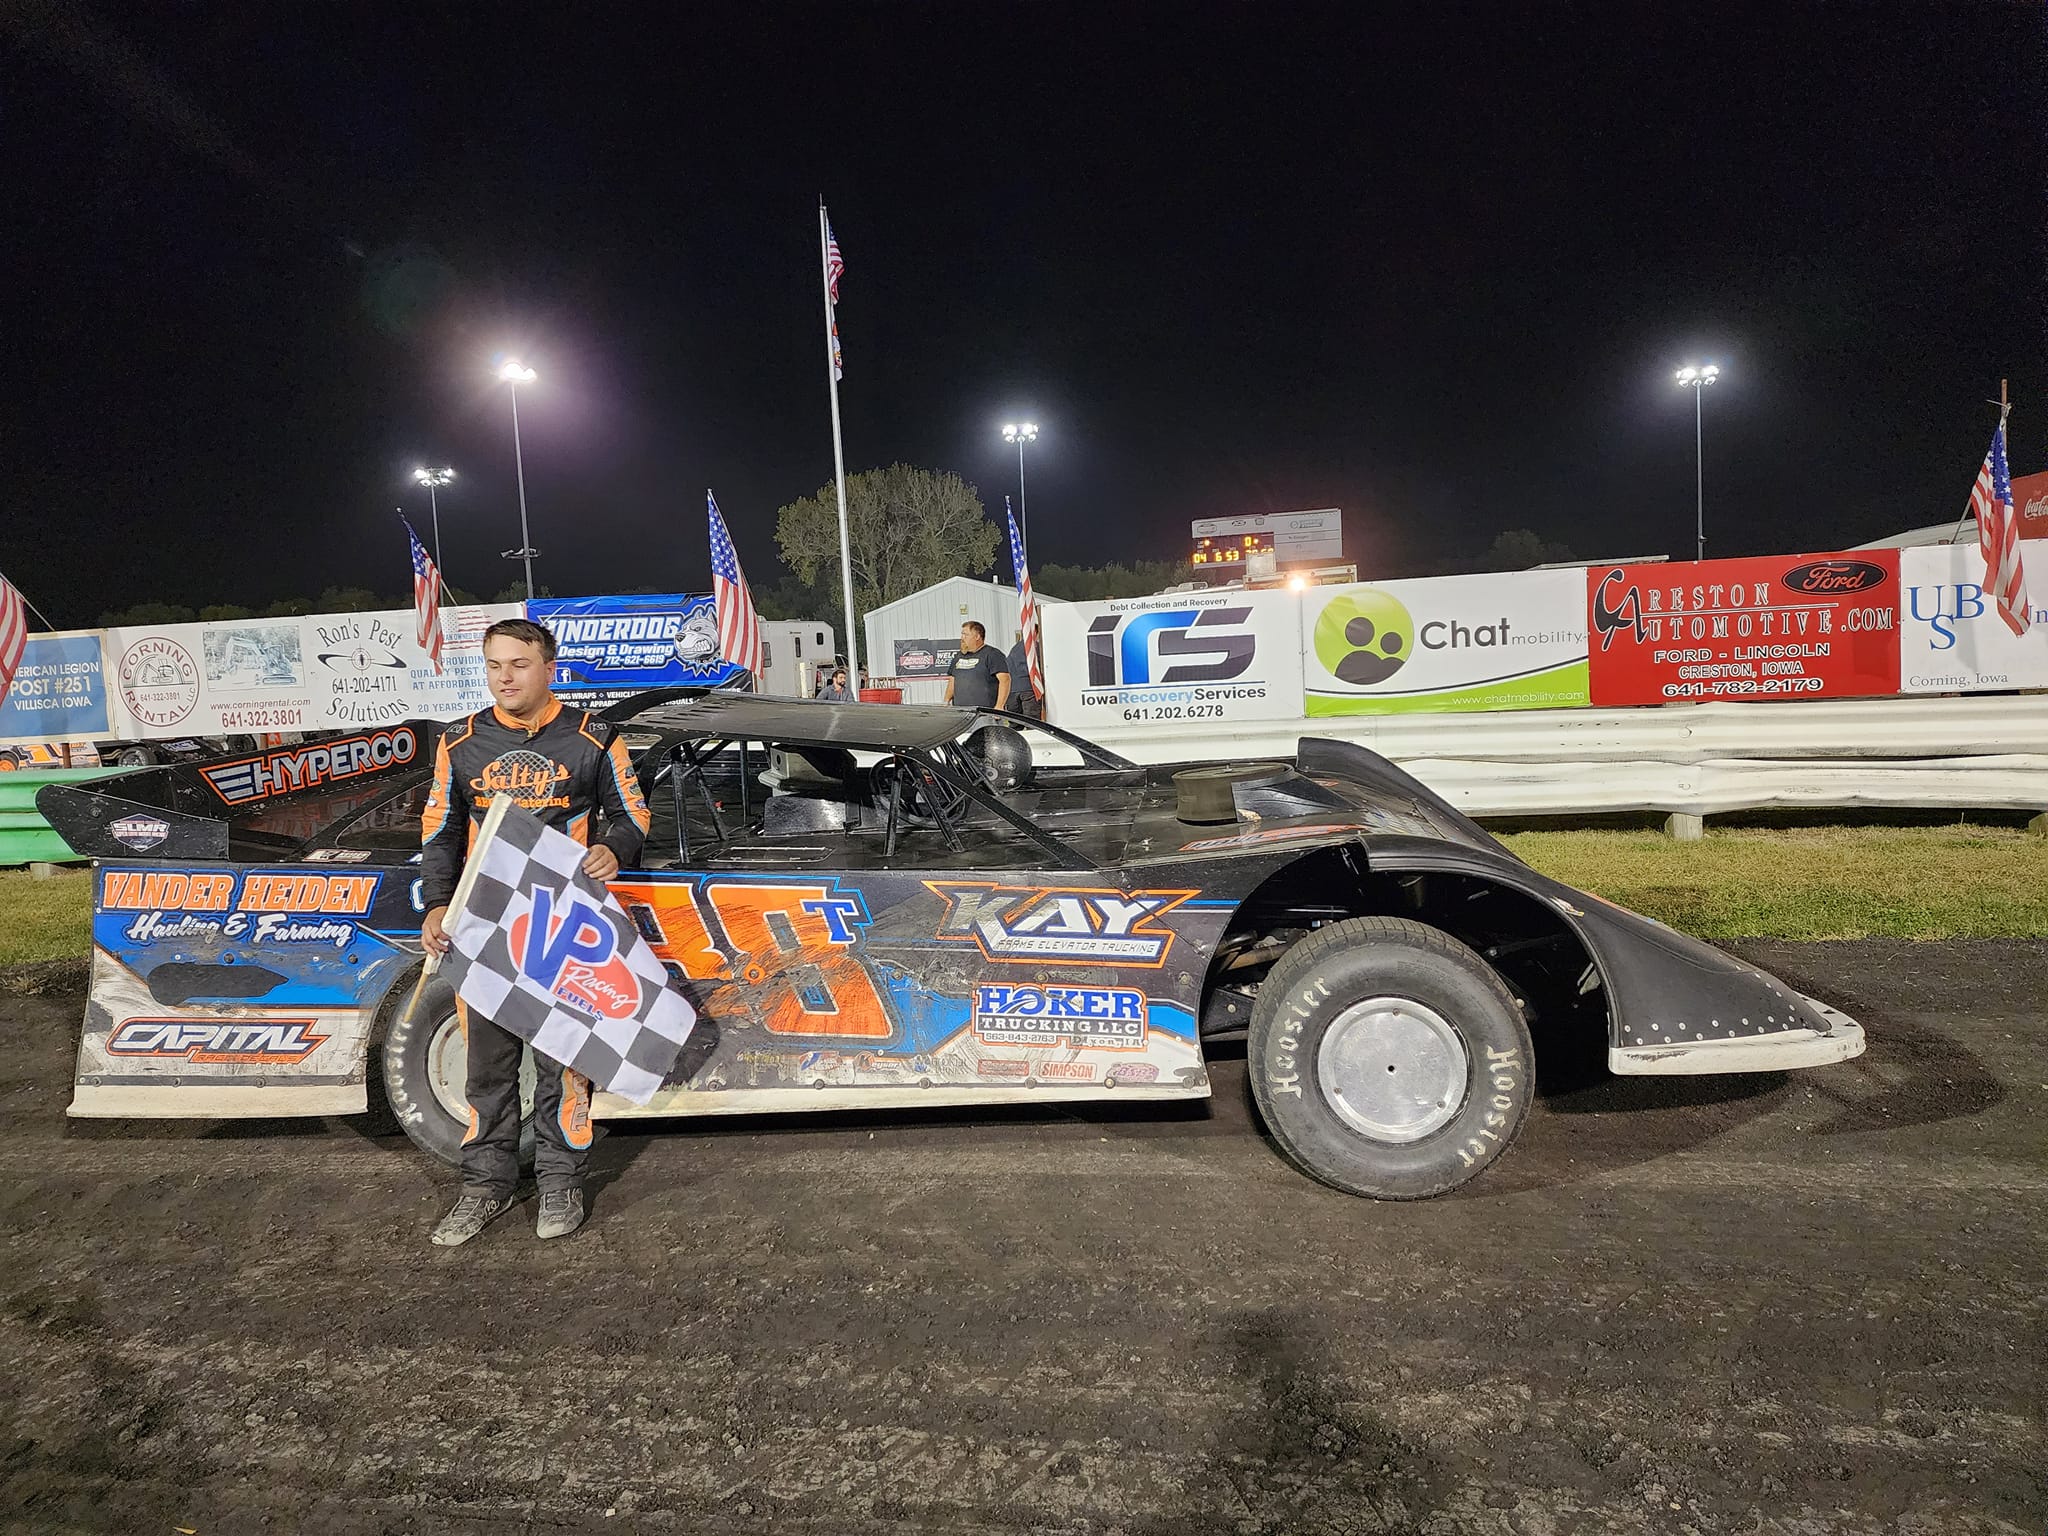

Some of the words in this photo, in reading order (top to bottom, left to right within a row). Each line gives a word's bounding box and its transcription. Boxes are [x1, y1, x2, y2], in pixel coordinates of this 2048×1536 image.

[1802, 566, 1865, 590] Ford
[1110, 603, 1129, 611] Debt
[1130, 600, 1171, 610] Collection
[1173, 599, 1188, 608] and
[1190, 598, 1228, 608] Recovery
[317, 619, 360, 648] Ron's
[369, 619, 404, 649] Pest
[1420, 618, 1511, 650] Chat
[558, 645, 605, 658] Design
[606, 644, 618, 655] &
[619, 643, 674, 656] Drawing
[1653, 650, 1712, 663] FORD
[1735, 643, 1830, 659] LINCOLN
[14, 664, 56, 677] ERICAN
[58, 661, 98, 674] LEGION
[123, 643, 192, 680] CORNING
[441, 655, 484, 667] PROVIDIN
[1678, 664, 1757, 680] CRESTON,
[1762, 661, 1804, 676] IOWA
[410, 667, 450, 679] QUALY
[454, 666, 479, 676] PEST
[1909, 675, 1970, 688] Corning,
[1975, 673, 2008, 684] Iowa
[9, 677, 49, 696] POST
[53, 676, 90, 693] #251
[332, 676, 397, 694] 641-202-4171
[412, 681, 425, 691] AT
[429, 678, 489, 690] AFFORDABLE
[1662, 678, 1824, 697] 641-782-2179
[14, 697, 59, 710] VILLISCA
[60, 695, 91, 707] IOWA
[210, 698, 311, 710] www.corningrental.com
[457, 691, 483, 700] WITH
[571, 691, 597, 699] WRAPS
[1452, 691, 1585, 705] www.chatmobility.com
[126, 691, 190, 722] RENTAL
[325, 697, 410, 723] Solutions
[418, 703, 429, 712] 20
[432, 702, 464, 712] YEARS
[1123, 705, 1224, 721] 641.202.6278
[221, 710, 303, 729] 641-322-3801
[207, 731, 414, 800] HYPERCO
[469, 759, 572, 795] Salty's
[113, 823, 167, 832] SLMR
[103, 872, 235, 911] VANDER
[239, 874, 376, 913] HEIDEN
[127, 911, 219, 943] Hauling
[224, 913, 248, 935] &
[253, 914, 354, 946] Farming
[949, 892, 1161, 951] KAY
[521, 885, 618, 990] VP
[1037, 940, 1096, 951] ELEVATOR
[1101, 942, 1156, 954] TRUCKING
[561, 964, 638, 1010] Racing
[556, 987, 606, 1022] FUELS
[977, 987, 1142, 1019] HOKER
[981, 1016, 1092, 1033] TRUCKING
[1097, 1021, 1140, 1035] LLC
[112, 1023, 317, 1052] CAPITAL
[1270, 976, 1331, 1099] Hoosier
[1041, 1062, 1094, 1079] SIMPSON
[1457, 1045, 1523, 1168] Hoosier
